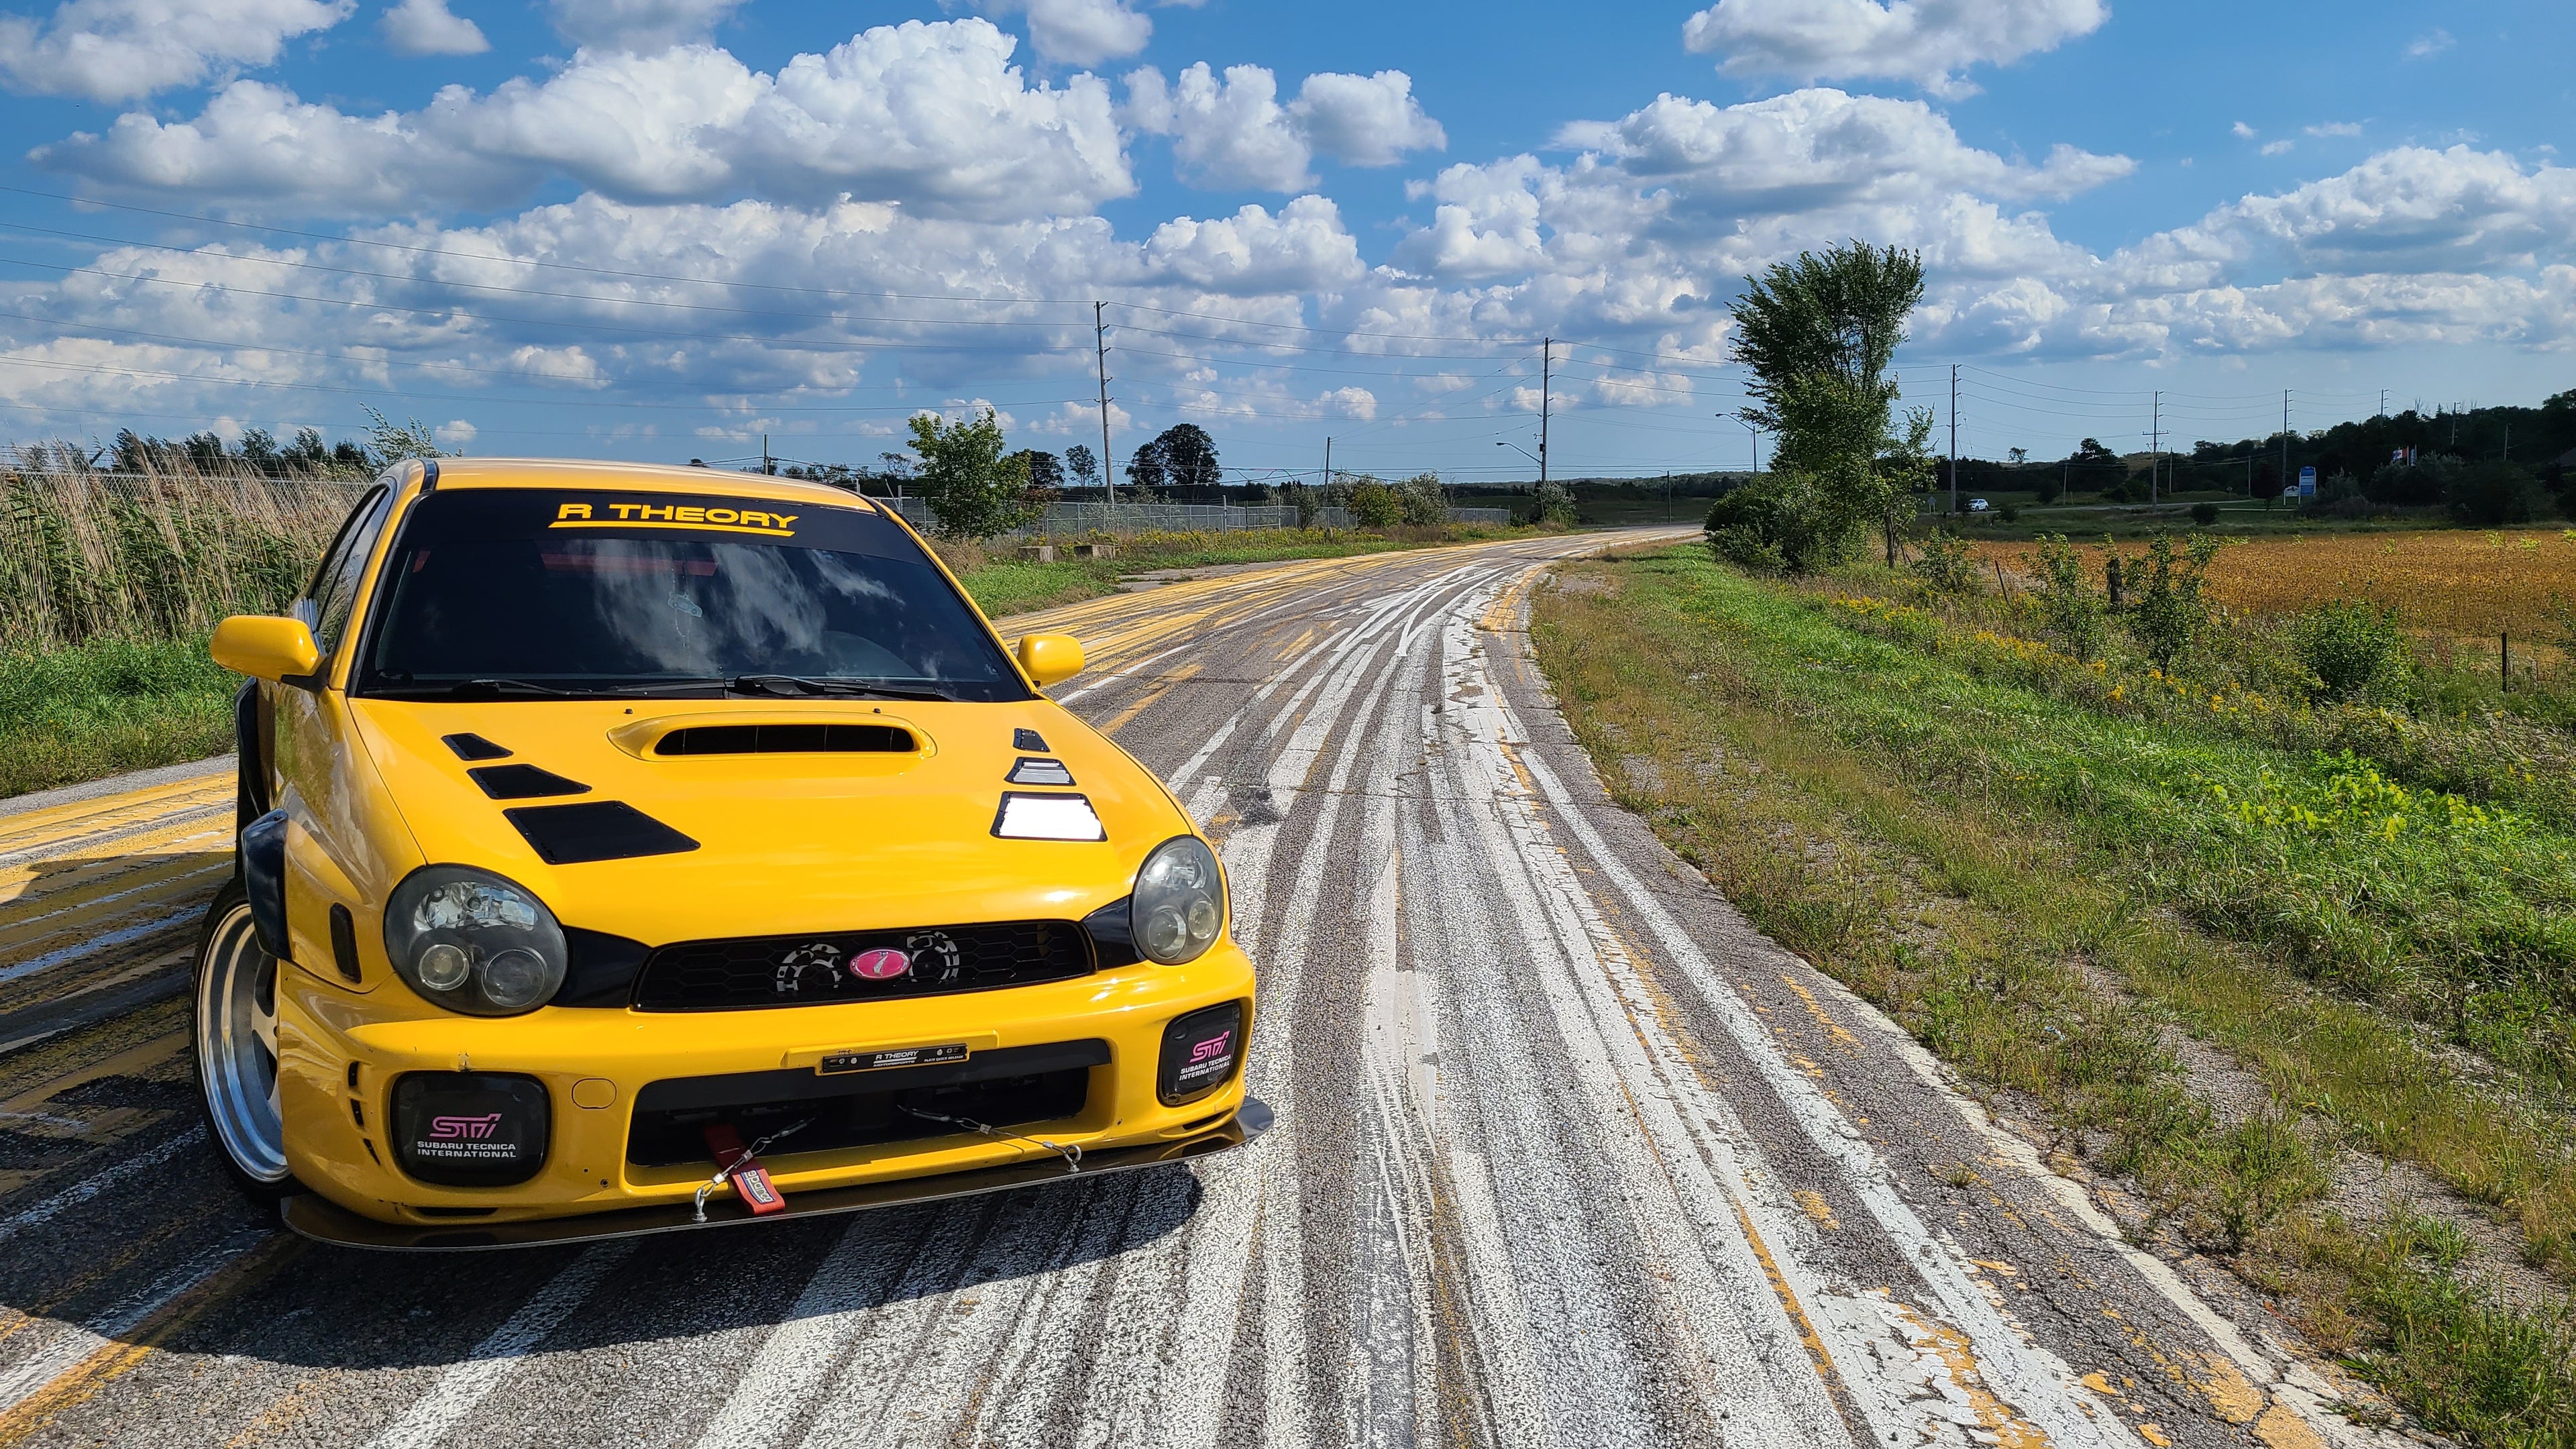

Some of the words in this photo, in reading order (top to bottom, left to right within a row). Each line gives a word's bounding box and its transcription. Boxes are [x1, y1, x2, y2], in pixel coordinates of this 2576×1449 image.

[558, 503, 593, 519] R
[608, 504, 800, 529] THEORY
[884, 1050, 919, 1059] THEORY
[1179, 1061, 1230, 1081] INTERNATIONAL
[1181, 1062, 1208, 1074] SUBARU
[1208, 1054, 1231, 1067] TECNICA
[417, 1141, 463, 1150] SUBARU
[466, 1142, 516, 1150] TECNICA
[417, 1149, 517, 1158] INTERNATIONAL
